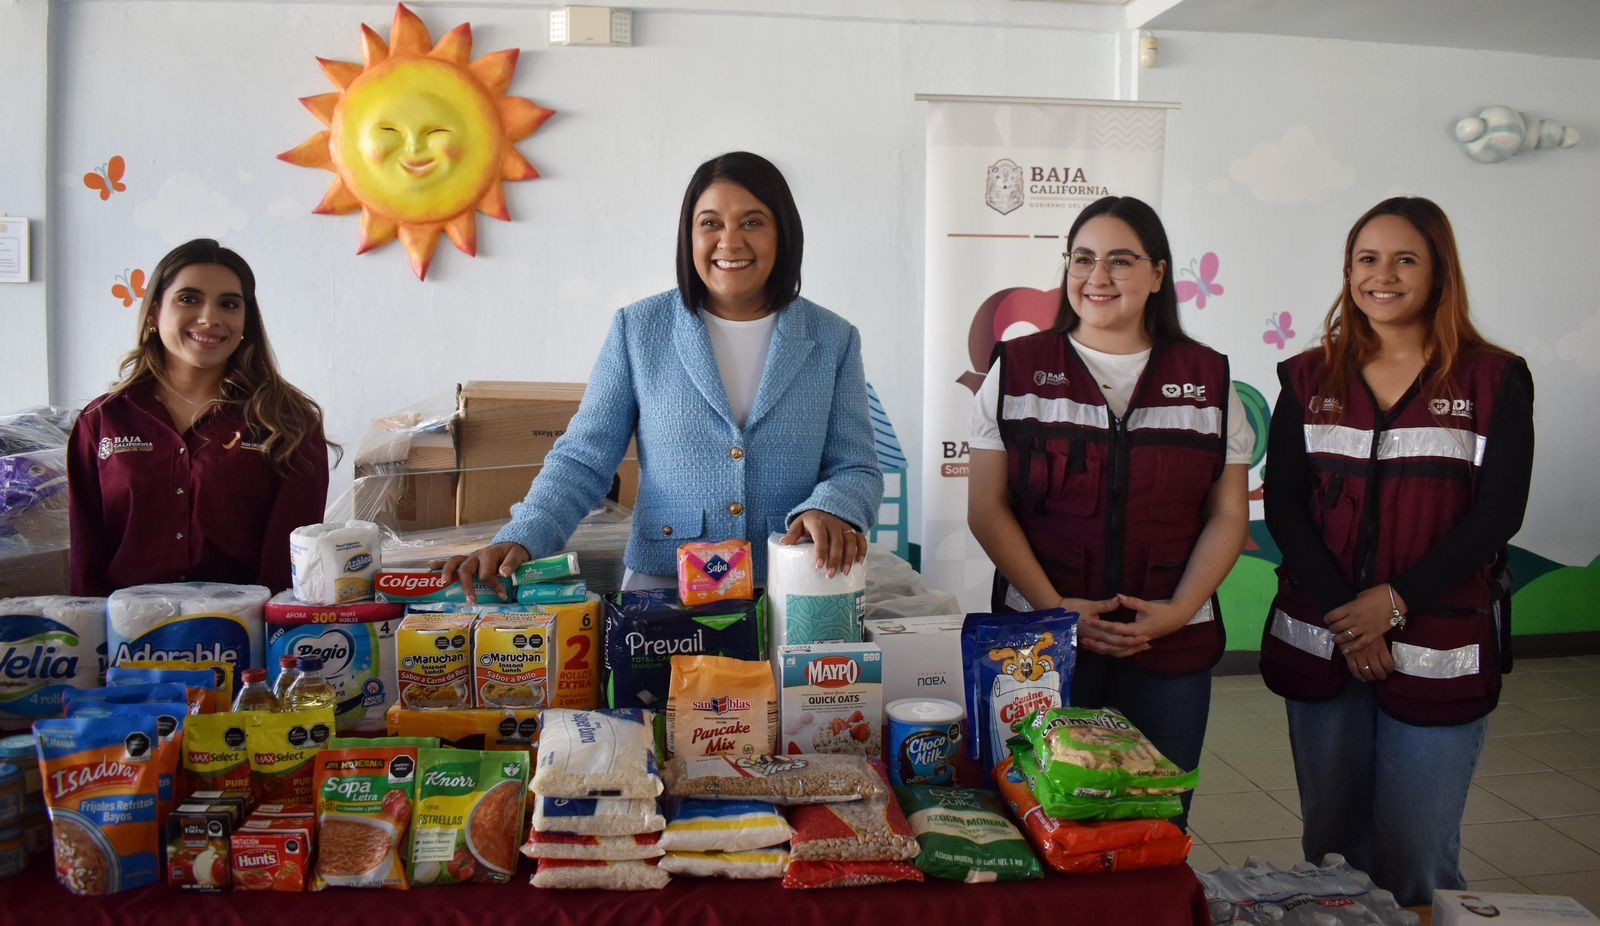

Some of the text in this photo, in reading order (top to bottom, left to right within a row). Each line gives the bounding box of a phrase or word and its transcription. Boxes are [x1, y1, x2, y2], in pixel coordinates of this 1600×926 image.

[1030, 166, 1087, 184] BAJA
[1030, 184, 1109, 196] CALIFORNIA
[113, 441, 154, 449] CALIFORNIA
[114, 435, 142, 443] BAJA
[942, 441, 970, 458] BA
[945, 465, 970, 475] Som
[706, 561, 728, 574] Saba
[378, 574, 447, 590] Colgate
[311, 611, 337, 624] 300
[582, 613, 591, 627] 6
[380, 621, 390, 634] 4
[625, 629, 704, 657] Prevail
[115, 642, 238, 666] Adorable
[298, 644, 347, 663] Regio
[412, 653, 464, 664] Maruchan
[490, 652, 541, 663] Maruchan
[564, 634, 591, 671] 2
[401, 671, 421, 683] Sabor
[426, 674, 446, 684] Carne
[447, 672, 455, 681] de
[454, 667, 467, 679] Res
[486, 671, 509, 683] Sabor
[516, 671, 537, 682] Pollo
[559, 671, 593, 680] ROLLOS
[808, 660, 858, 686] MAYPO
[558, 680, 592, 690] EXTRA
[30, 693, 61, 704] 4 roll
[692, 699, 751, 709] san blas
[808, 694, 860, 705] QUICK OATS
[1012, 690, 1044, 706] Canine
[1000, 695, 1053, 724] Carry
[691, 721, 750, 745] Pancake
[705, 740, 735, 755] Mix
[909, 736, 946, 754] Choco
[190, 752, 239, 763] MAX Select
[255, 751, 304, 765] MAX Select
[914, 748, 946, 765] Milk
[51, 754, 136, 799] Isadora
[292, 777, 313, 787] PUR
[424, 771, 476, 788] Knorr
[324, 776, 371, 798] Sopa
[352, 792, 378, 802] Letra
[80, 798, 154, 813] Frijoles Refritos
[102, 811, 132, 823] Bayos
[418, 815, 463, 826] ESTRELLAS
[927, 813, 1009, 829] AZÚCAR MORENA
[237, 853, 277, 867] Hunt's
